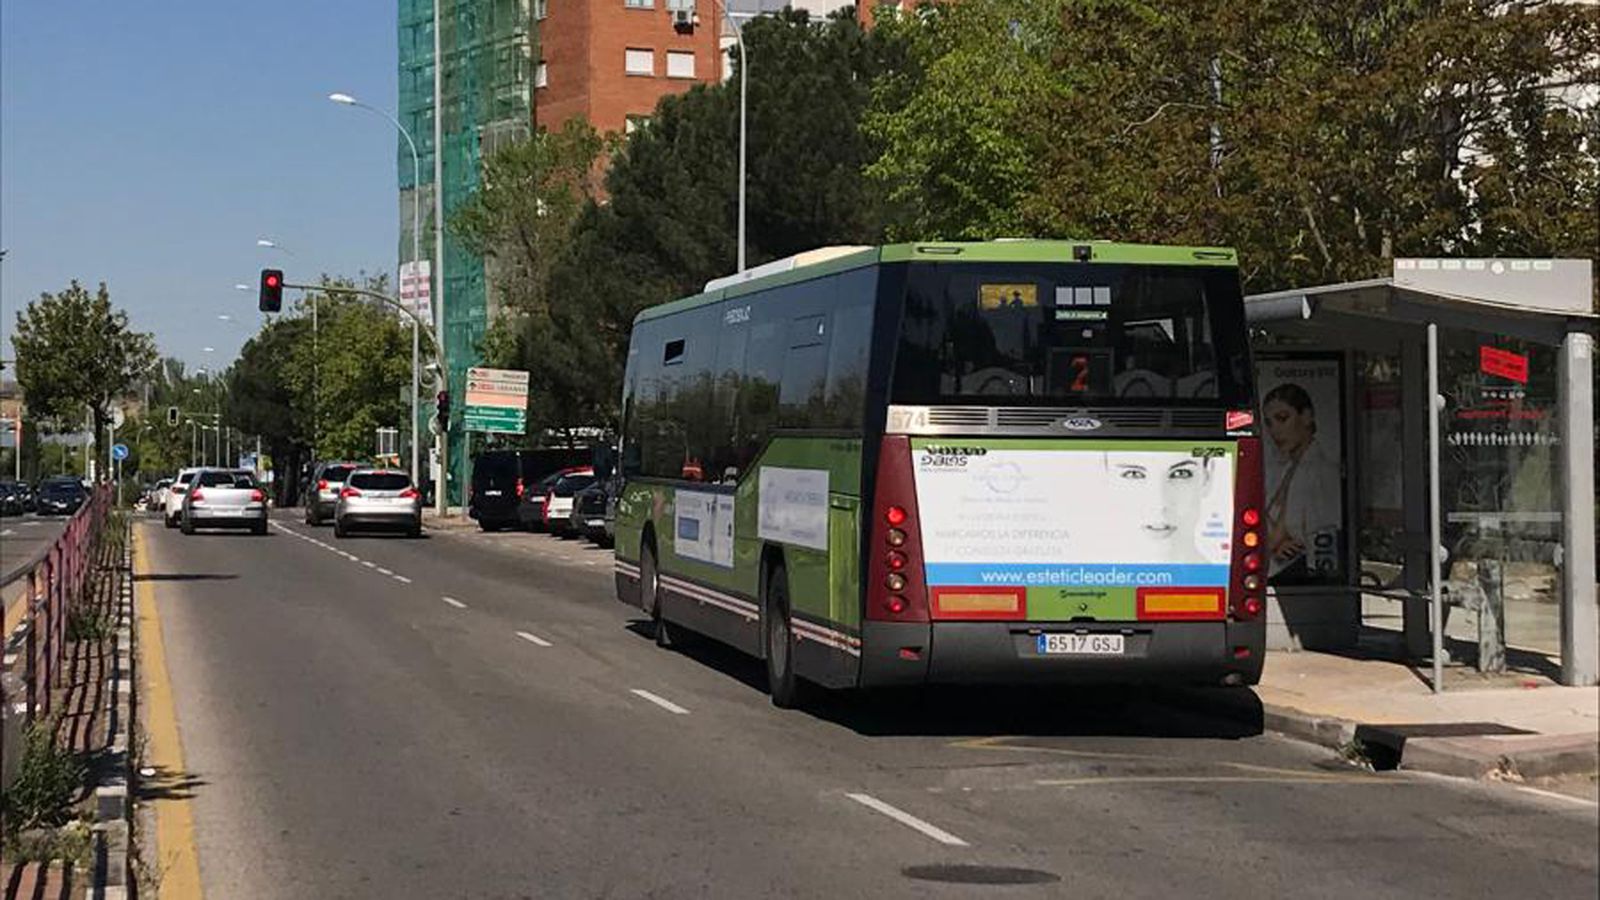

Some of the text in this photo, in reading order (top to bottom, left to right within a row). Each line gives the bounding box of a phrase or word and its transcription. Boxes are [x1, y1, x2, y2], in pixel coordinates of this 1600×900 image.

[1070, 357, 1088, 391] 2
[923, 446, 988, 457] VOLVO
[1048, 635, 1122, 652] 6517 GSJ
